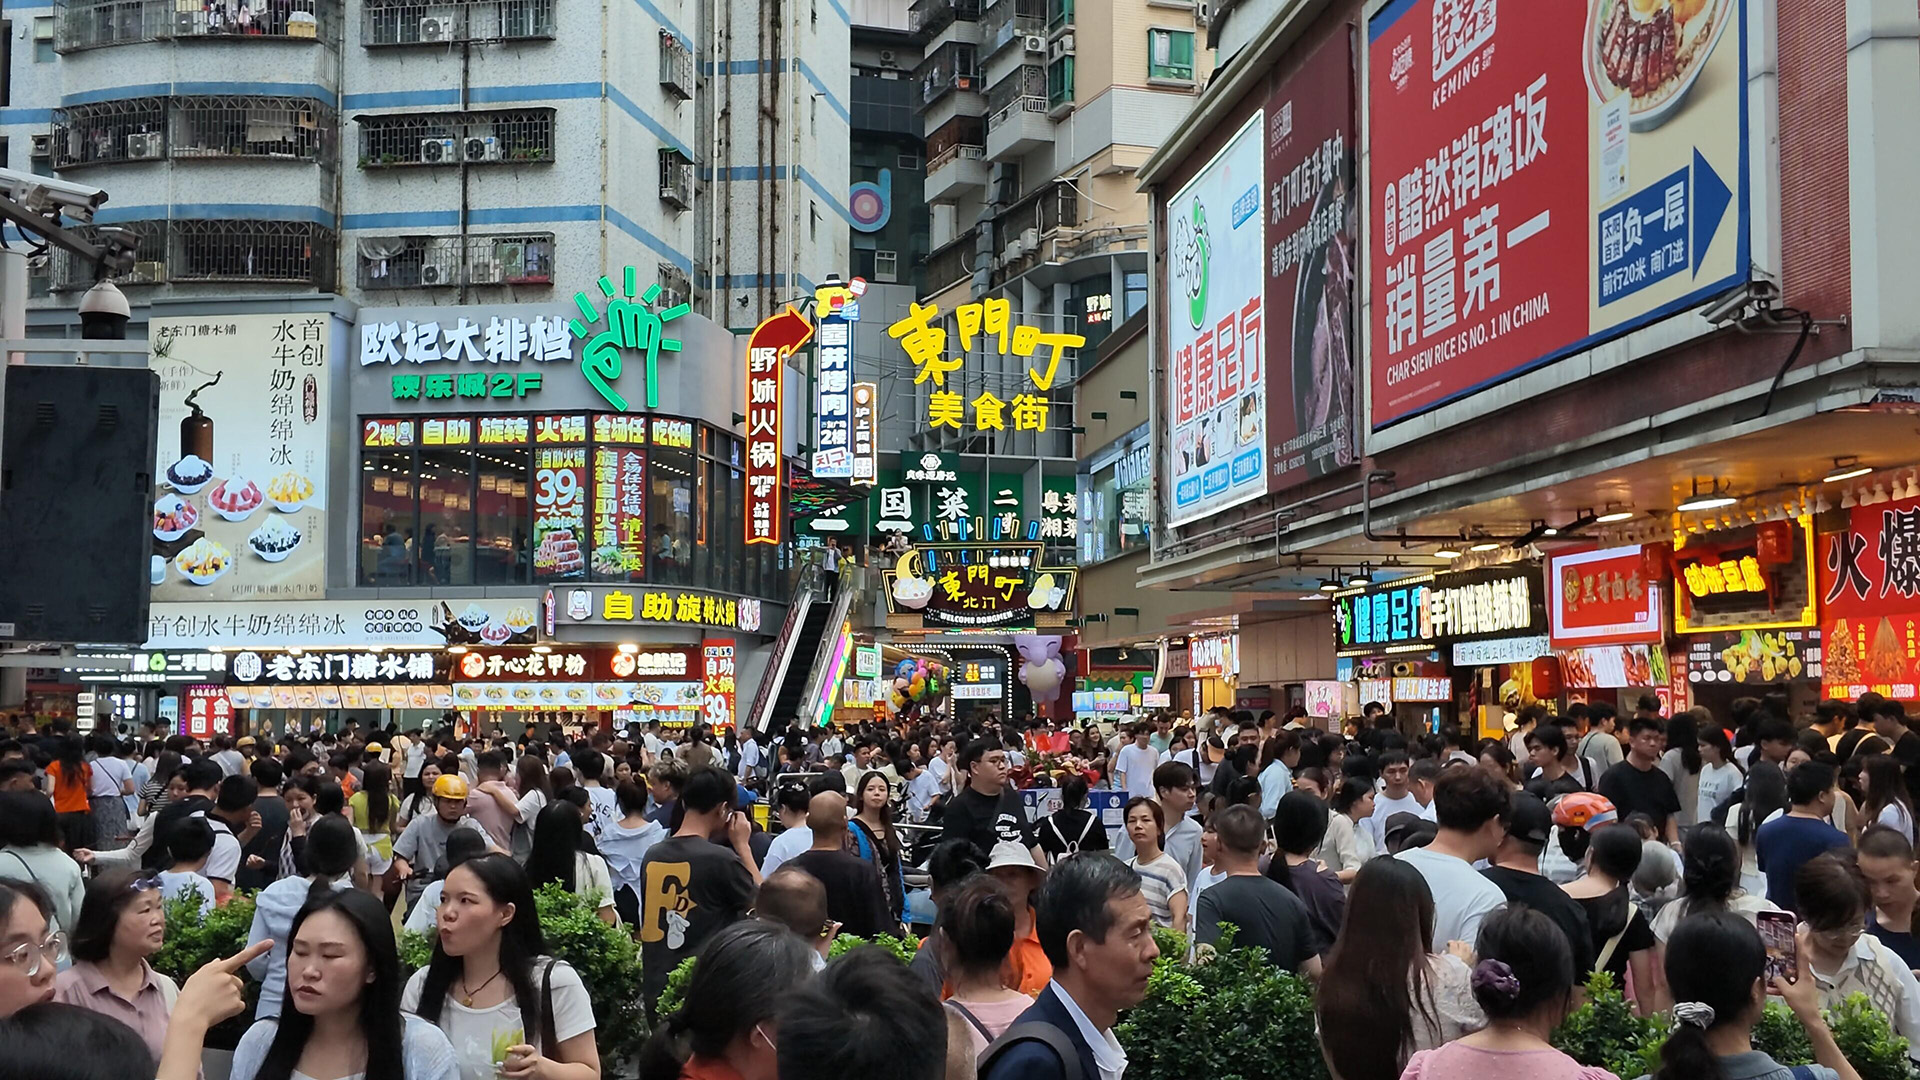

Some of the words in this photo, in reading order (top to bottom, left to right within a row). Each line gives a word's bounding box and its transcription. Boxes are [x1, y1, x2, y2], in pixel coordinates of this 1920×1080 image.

[1432, 56, 1479, 110] KEMING
[1272, 129, 1343, 225] 东门町店升级中
[1399, 74, 1547, 246] 黯然销魂饭
[1386, 192, 1395, 247] 中国
[1624, 181, 1685, 253] 负一层
[1386, 203, 1550, 355] 销量第一
[1602, 257, 1647, 297] 前行20米
[1650, 240, 1685, 276] 南门进
[157, 325, 237, 338] 老东门糖水铺
[298, 319, 324, 366] 首创
[360, 315, 572, 367] 欧记大排档
[888, 298, 1087, 392] 東門町
[1386, 360, 1411, 386] CHAR
[1411, 349, 1434, 376] SIEW
[1434, 336, 1456, 365] RICE
[1457, 331, 1468, 355] IS
[1469, 323, 1488, 350] NO.
[1490, 317, 1497, 340] 1
[1499, 311, 1511, 336] IN
[1512, 292, 1550, 330] CHINA
[1175, 296, 1261, 425] 健康足疗
[269, 319, 297, 465] 水牛奶绵绵冰
[750, 347, 777, 469] 野妹火锅
[928, 391, 1049, 432] 美食街
[365, 419, 395, 447] 2楼
[423, 419, 471, 445] 自助
[480, 417, 529, 443] 旋转
[536, 416, 586, 442] 火锅
[594, 415, 645, 444] 全场任
[652, 419, 692, 448] 吃任喝
[535, 469, 577, 506] 39
[594, 450, 619, 546] 旋转自助火锅
[620, 452, 642, 516] 全场任吃任喝
[939, 565, 1024, 602] 東門町
[150, 613, 346, 638] 首创水牛奶绵绵冰
[603, 590, 736, 628] 自助旋转火锅
[940, 612, 975, 624] WELCOME
[266, 653, 434, 681] 老东门糖水铺
[486, 654, 587, 677] 开心花甲粉
[705, 676, 735, 694] 火锅
[706, 658, 735, 676] 自助
[191, 698, 229, 715] 黄金
[191, 716, 229, 733] 回收
[704, 694, 726, 726] 39
[642, 861, 691, 942] F
[674, 896, 689, 912] D
